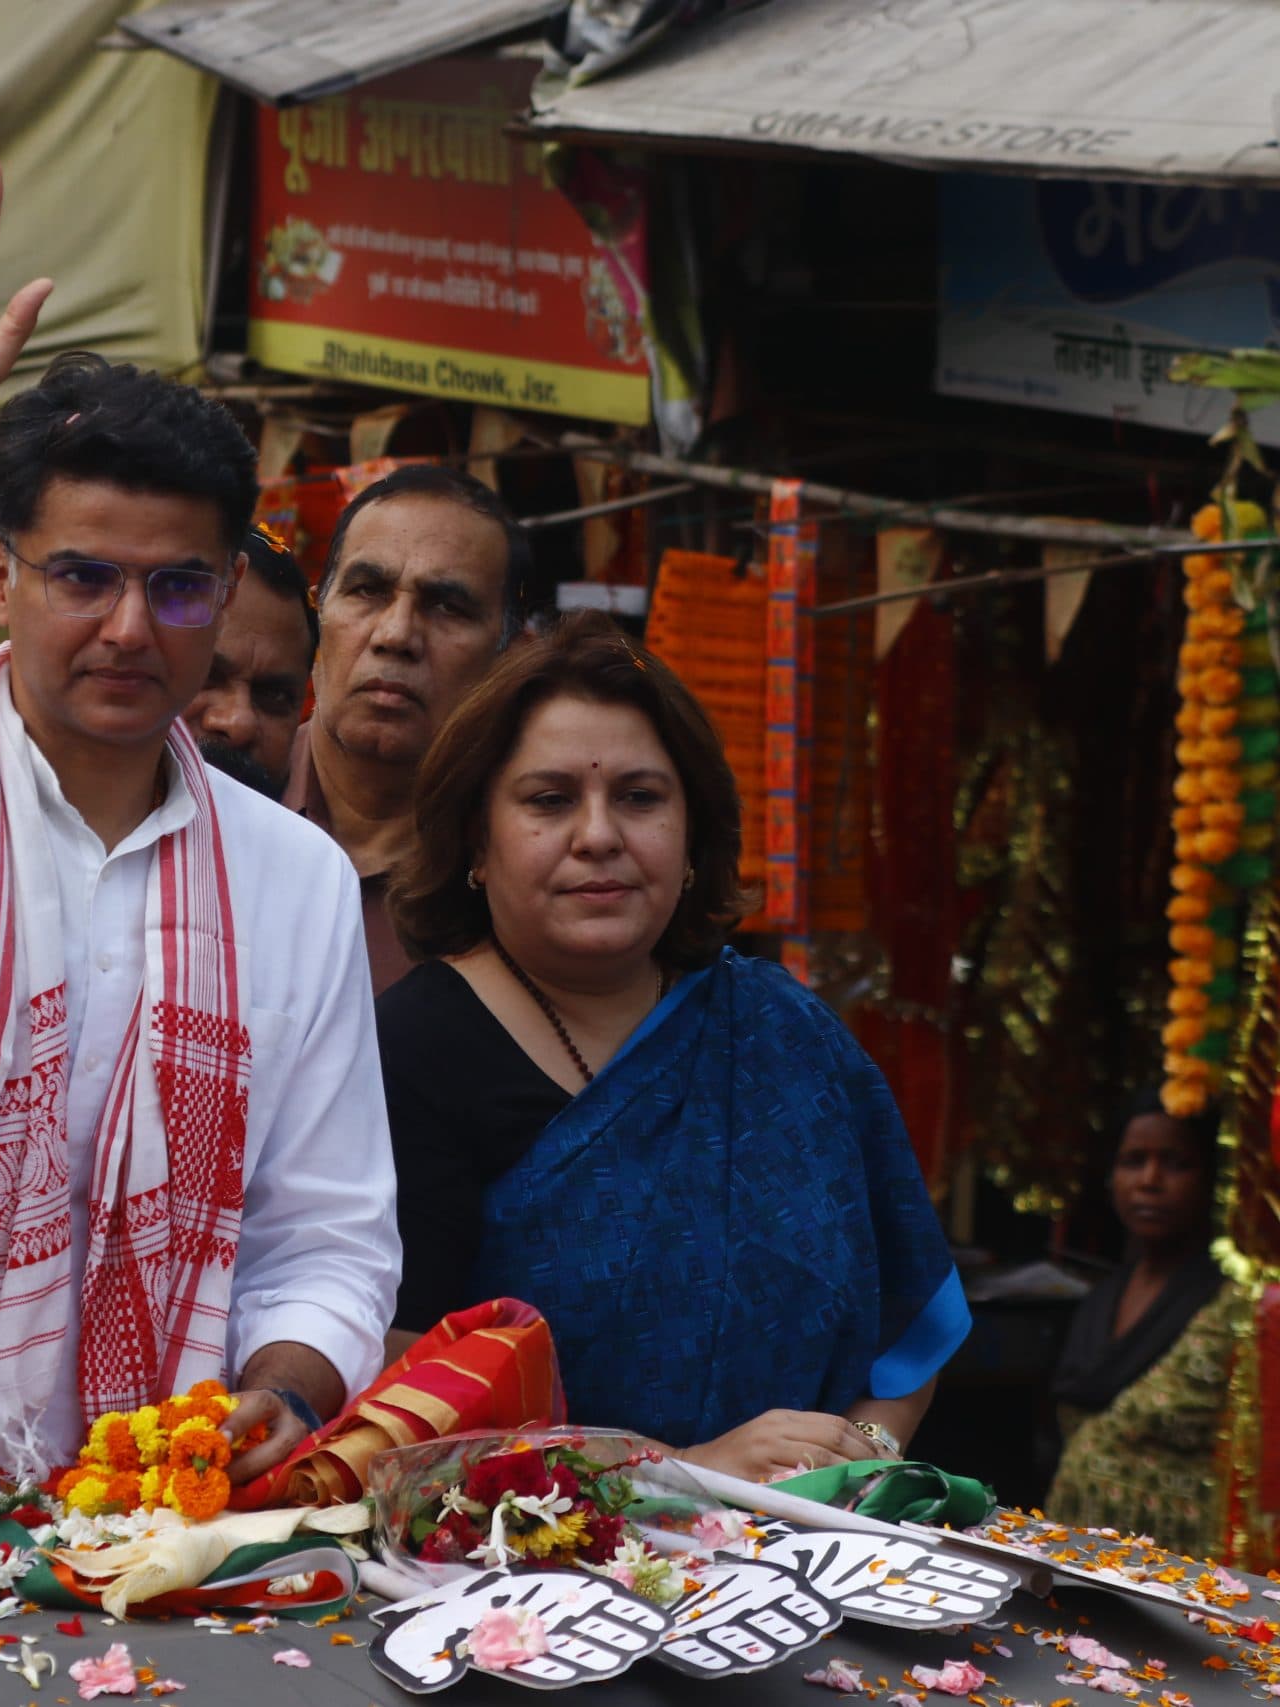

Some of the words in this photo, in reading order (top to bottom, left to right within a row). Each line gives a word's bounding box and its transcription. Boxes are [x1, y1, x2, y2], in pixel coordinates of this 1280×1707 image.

[939, 121, 1131, 155] STORE
[323, 341, 429, 385] Bhalubasa
[434, 357, 512, 400] Chowk,
